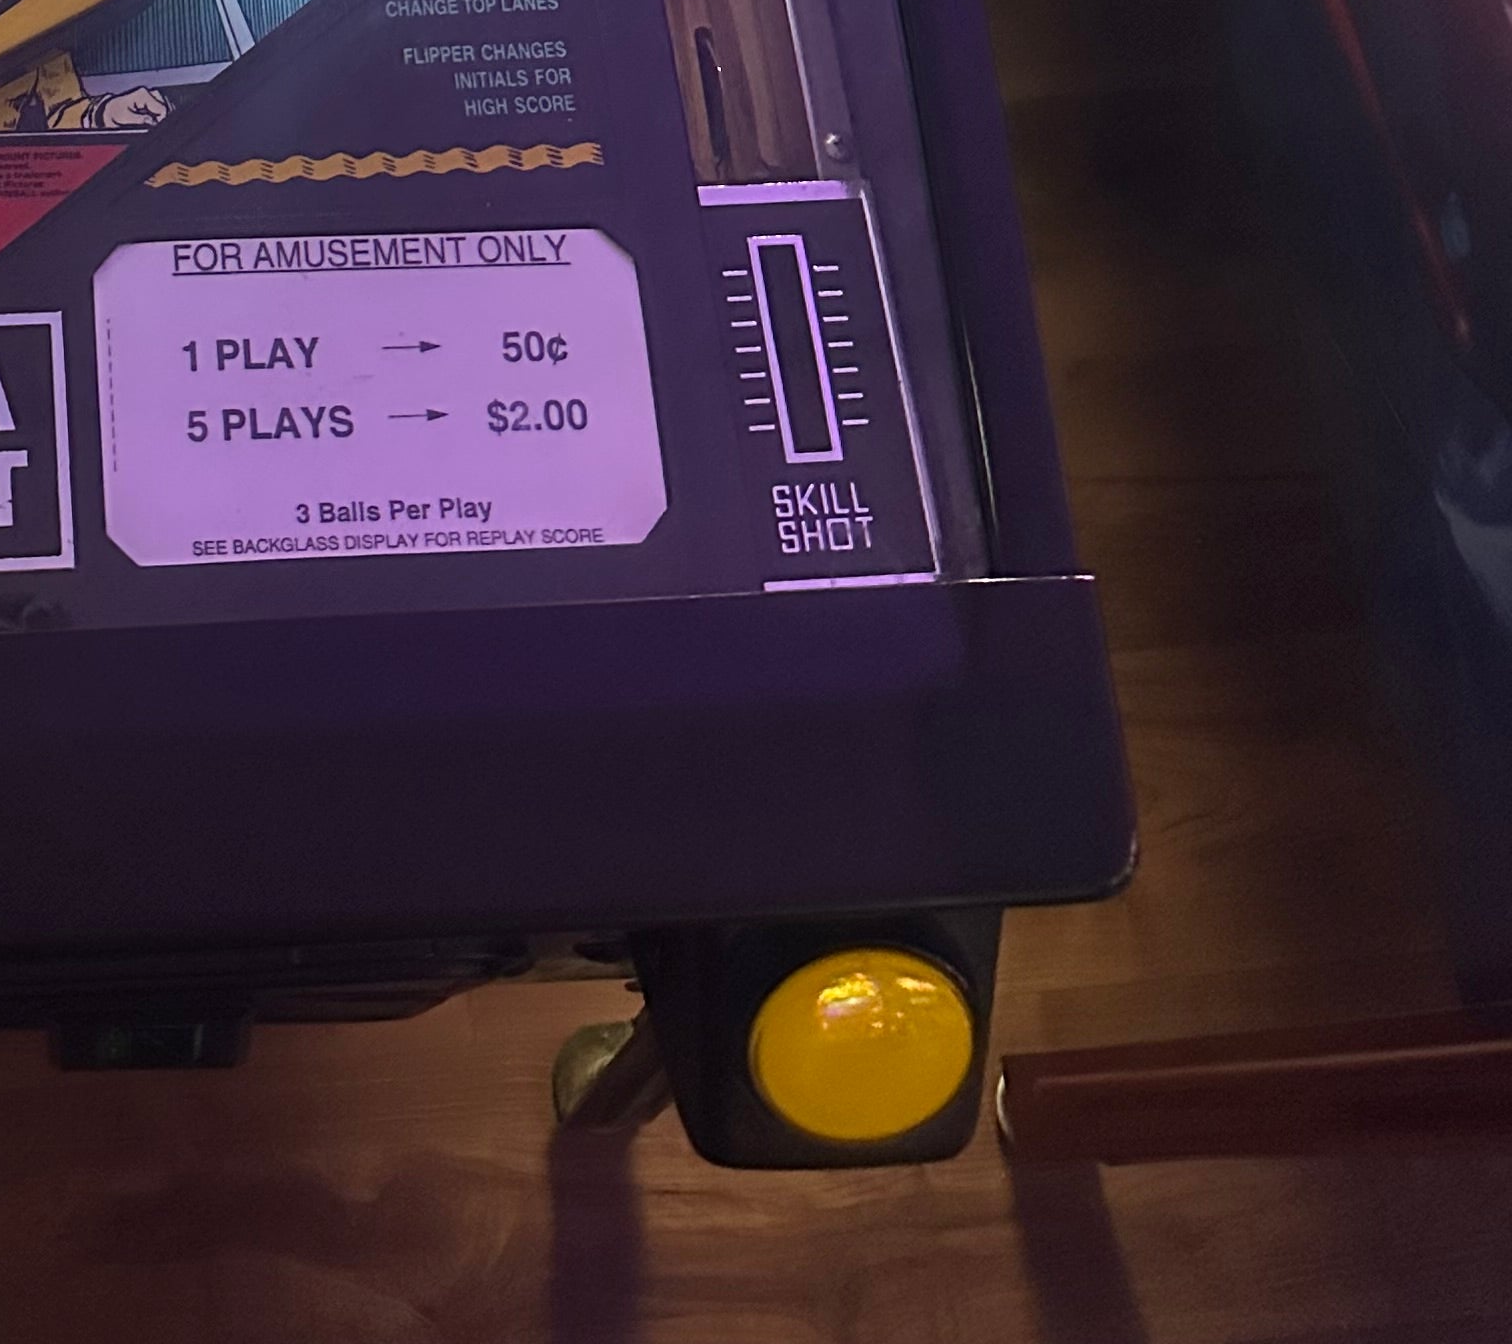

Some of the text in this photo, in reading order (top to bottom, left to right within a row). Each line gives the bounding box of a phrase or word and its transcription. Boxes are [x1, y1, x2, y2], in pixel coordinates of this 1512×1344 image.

[403, 40, 568, 66] FLIPPER CHANGES
[454, 67, 572, 90] INITIALS FOR
[464, 93, 577, 117] HIGH SCORE
[172, 234, 569, 272] FOR AMUSEMENT ONLY
[182, 330, 570, 372] 1 PLAY 50¢
[185, 399, 589, 442] 5 PLAYS $2.00
[295, 496, 494, 525] 3 Balls Per Play
[772, 483, 871, 517] SKILL
[192, 526, 606, 556] SEE BACKGLASS DISPLAY FOR REPLAY SCORE
[779, 516, 875, 554] SHOT
